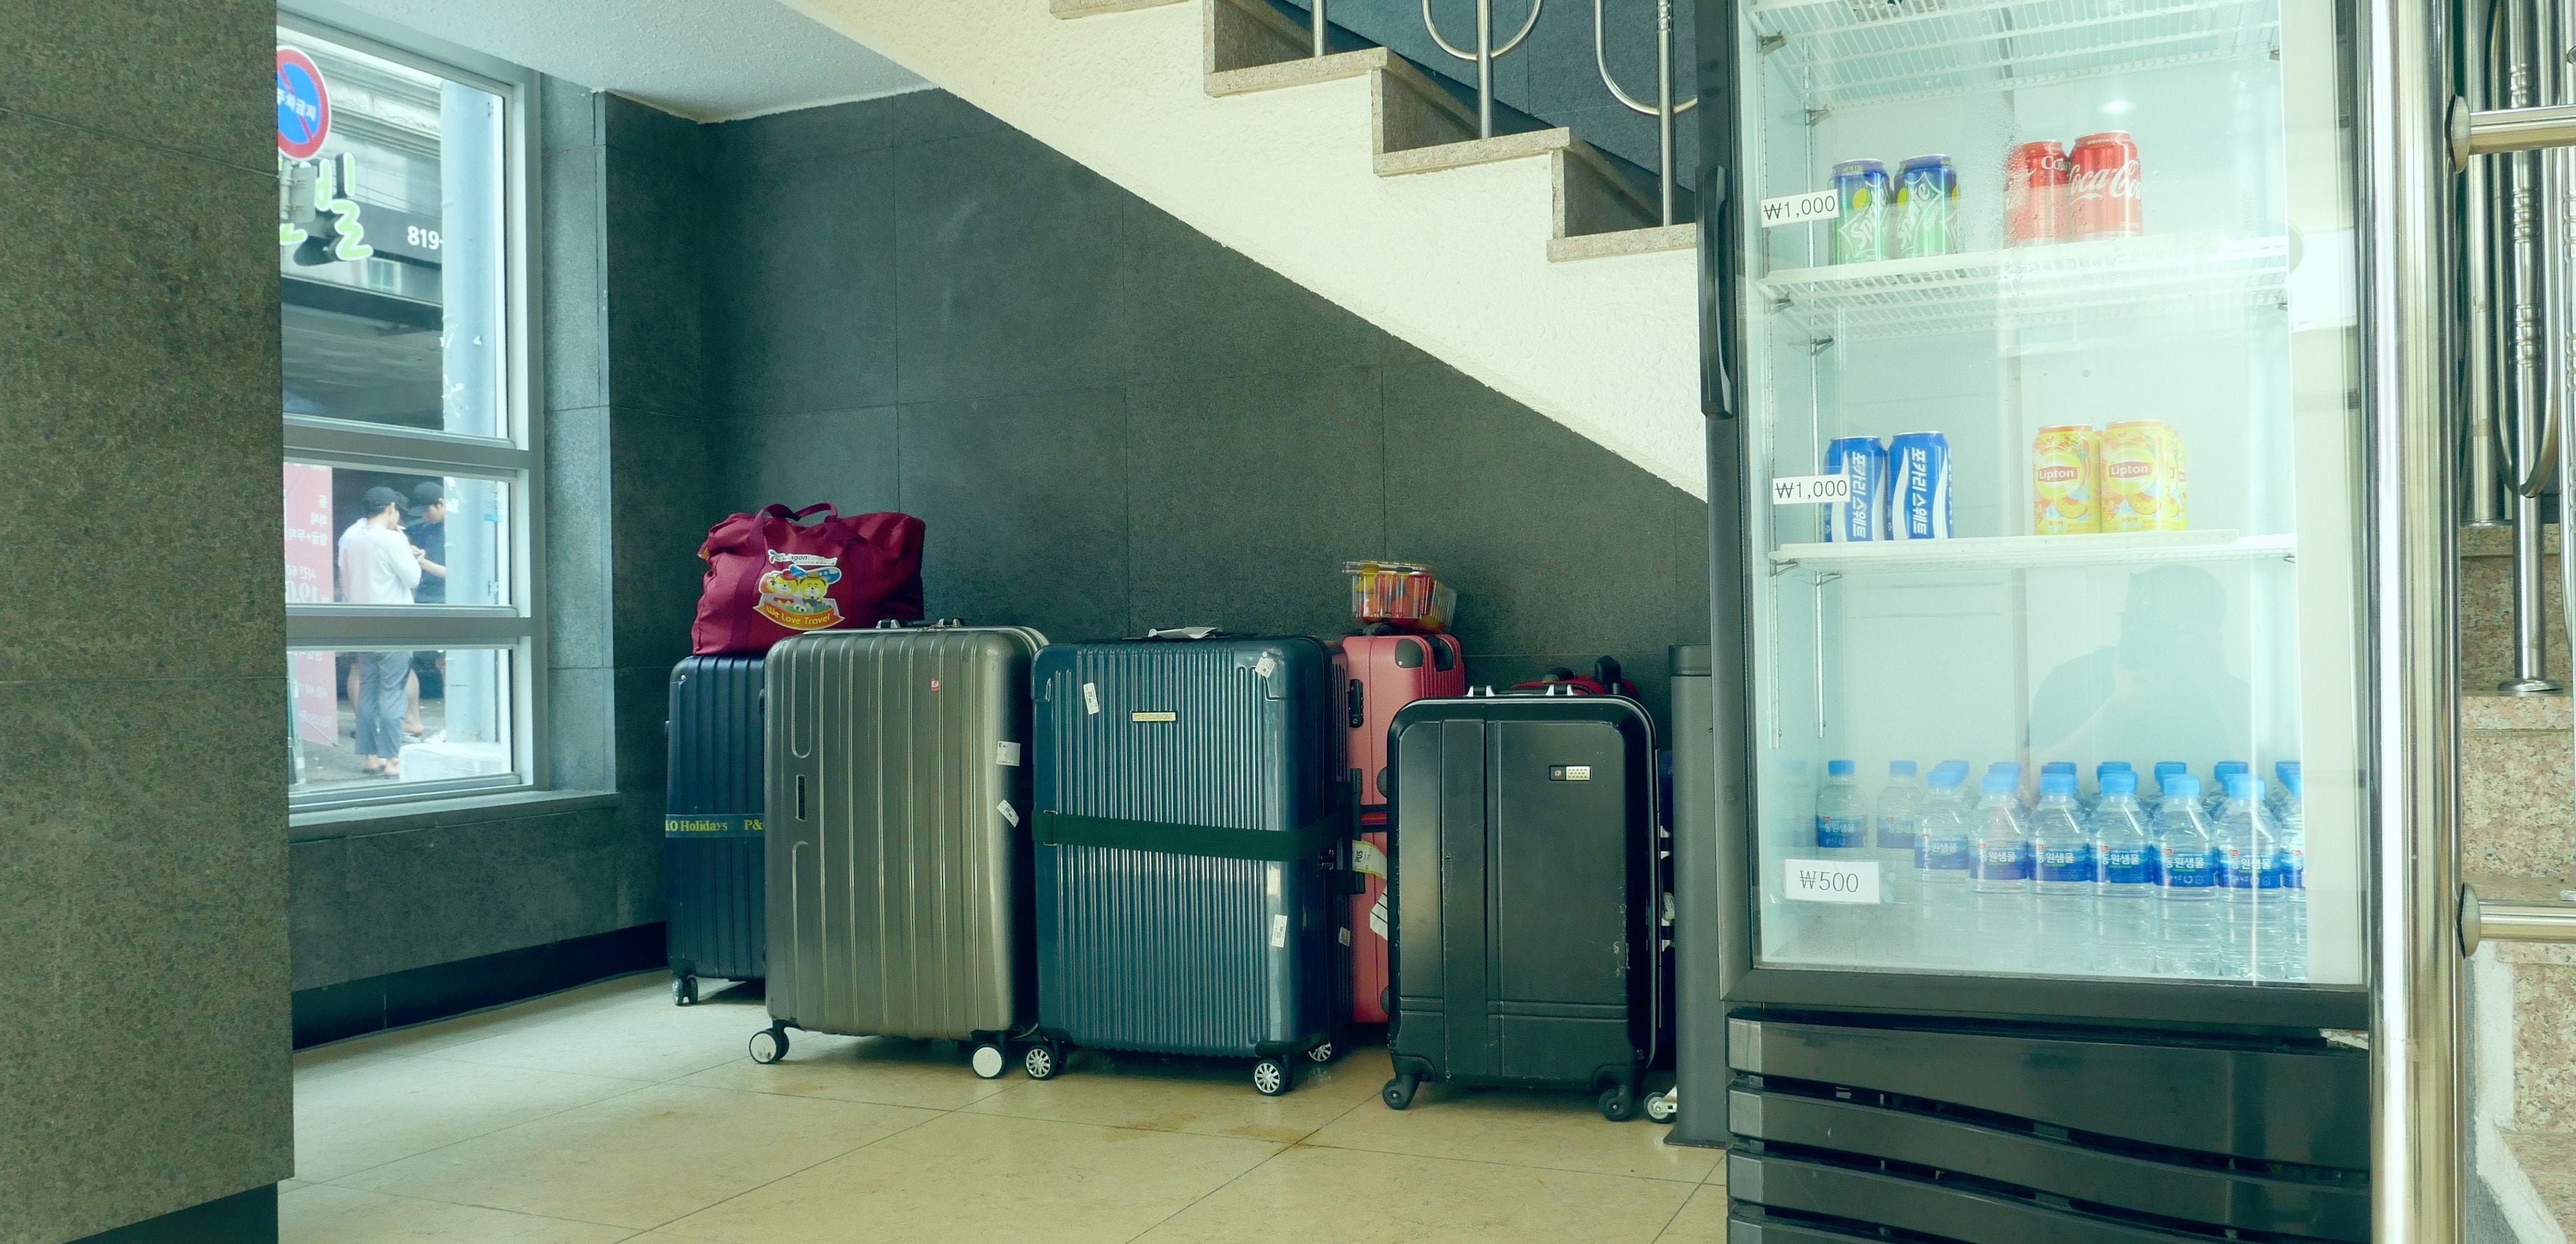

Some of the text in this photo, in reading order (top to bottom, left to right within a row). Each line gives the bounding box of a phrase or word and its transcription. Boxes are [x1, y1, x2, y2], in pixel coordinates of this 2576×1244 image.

[2070, 160, 2141, 200] Coca-Co
[1763, 195, 1835, 220] ₩1,000
[2039, 470, 2074, 481] Lipton
[2111, 465, 2149, 477] Lipton
[1774, 479, 1847, 500] ₩1,000
[1852, 451, 1867, 539] 포카리스웨트
[1912, 447, 1927, 535] 포카리스웨트
[767, 606, 830, 625] We Love Travel
[680, 820, 728, 832] Holidays
[744, 819, 763, 831] P&
[1355, 850, 1363, 863] PUS
[1979, 851, 2018, 862] 동원샘물
[2037, 852, 2075, 864] 동원샘물
[2102, 854, 2141, 865] 동원샘물
[2165, 857, 2204, 868] 동원샘물
[2231, 858, 2272, 870] 동원샘물
[1799, 870, 1859, 893] ₩500
